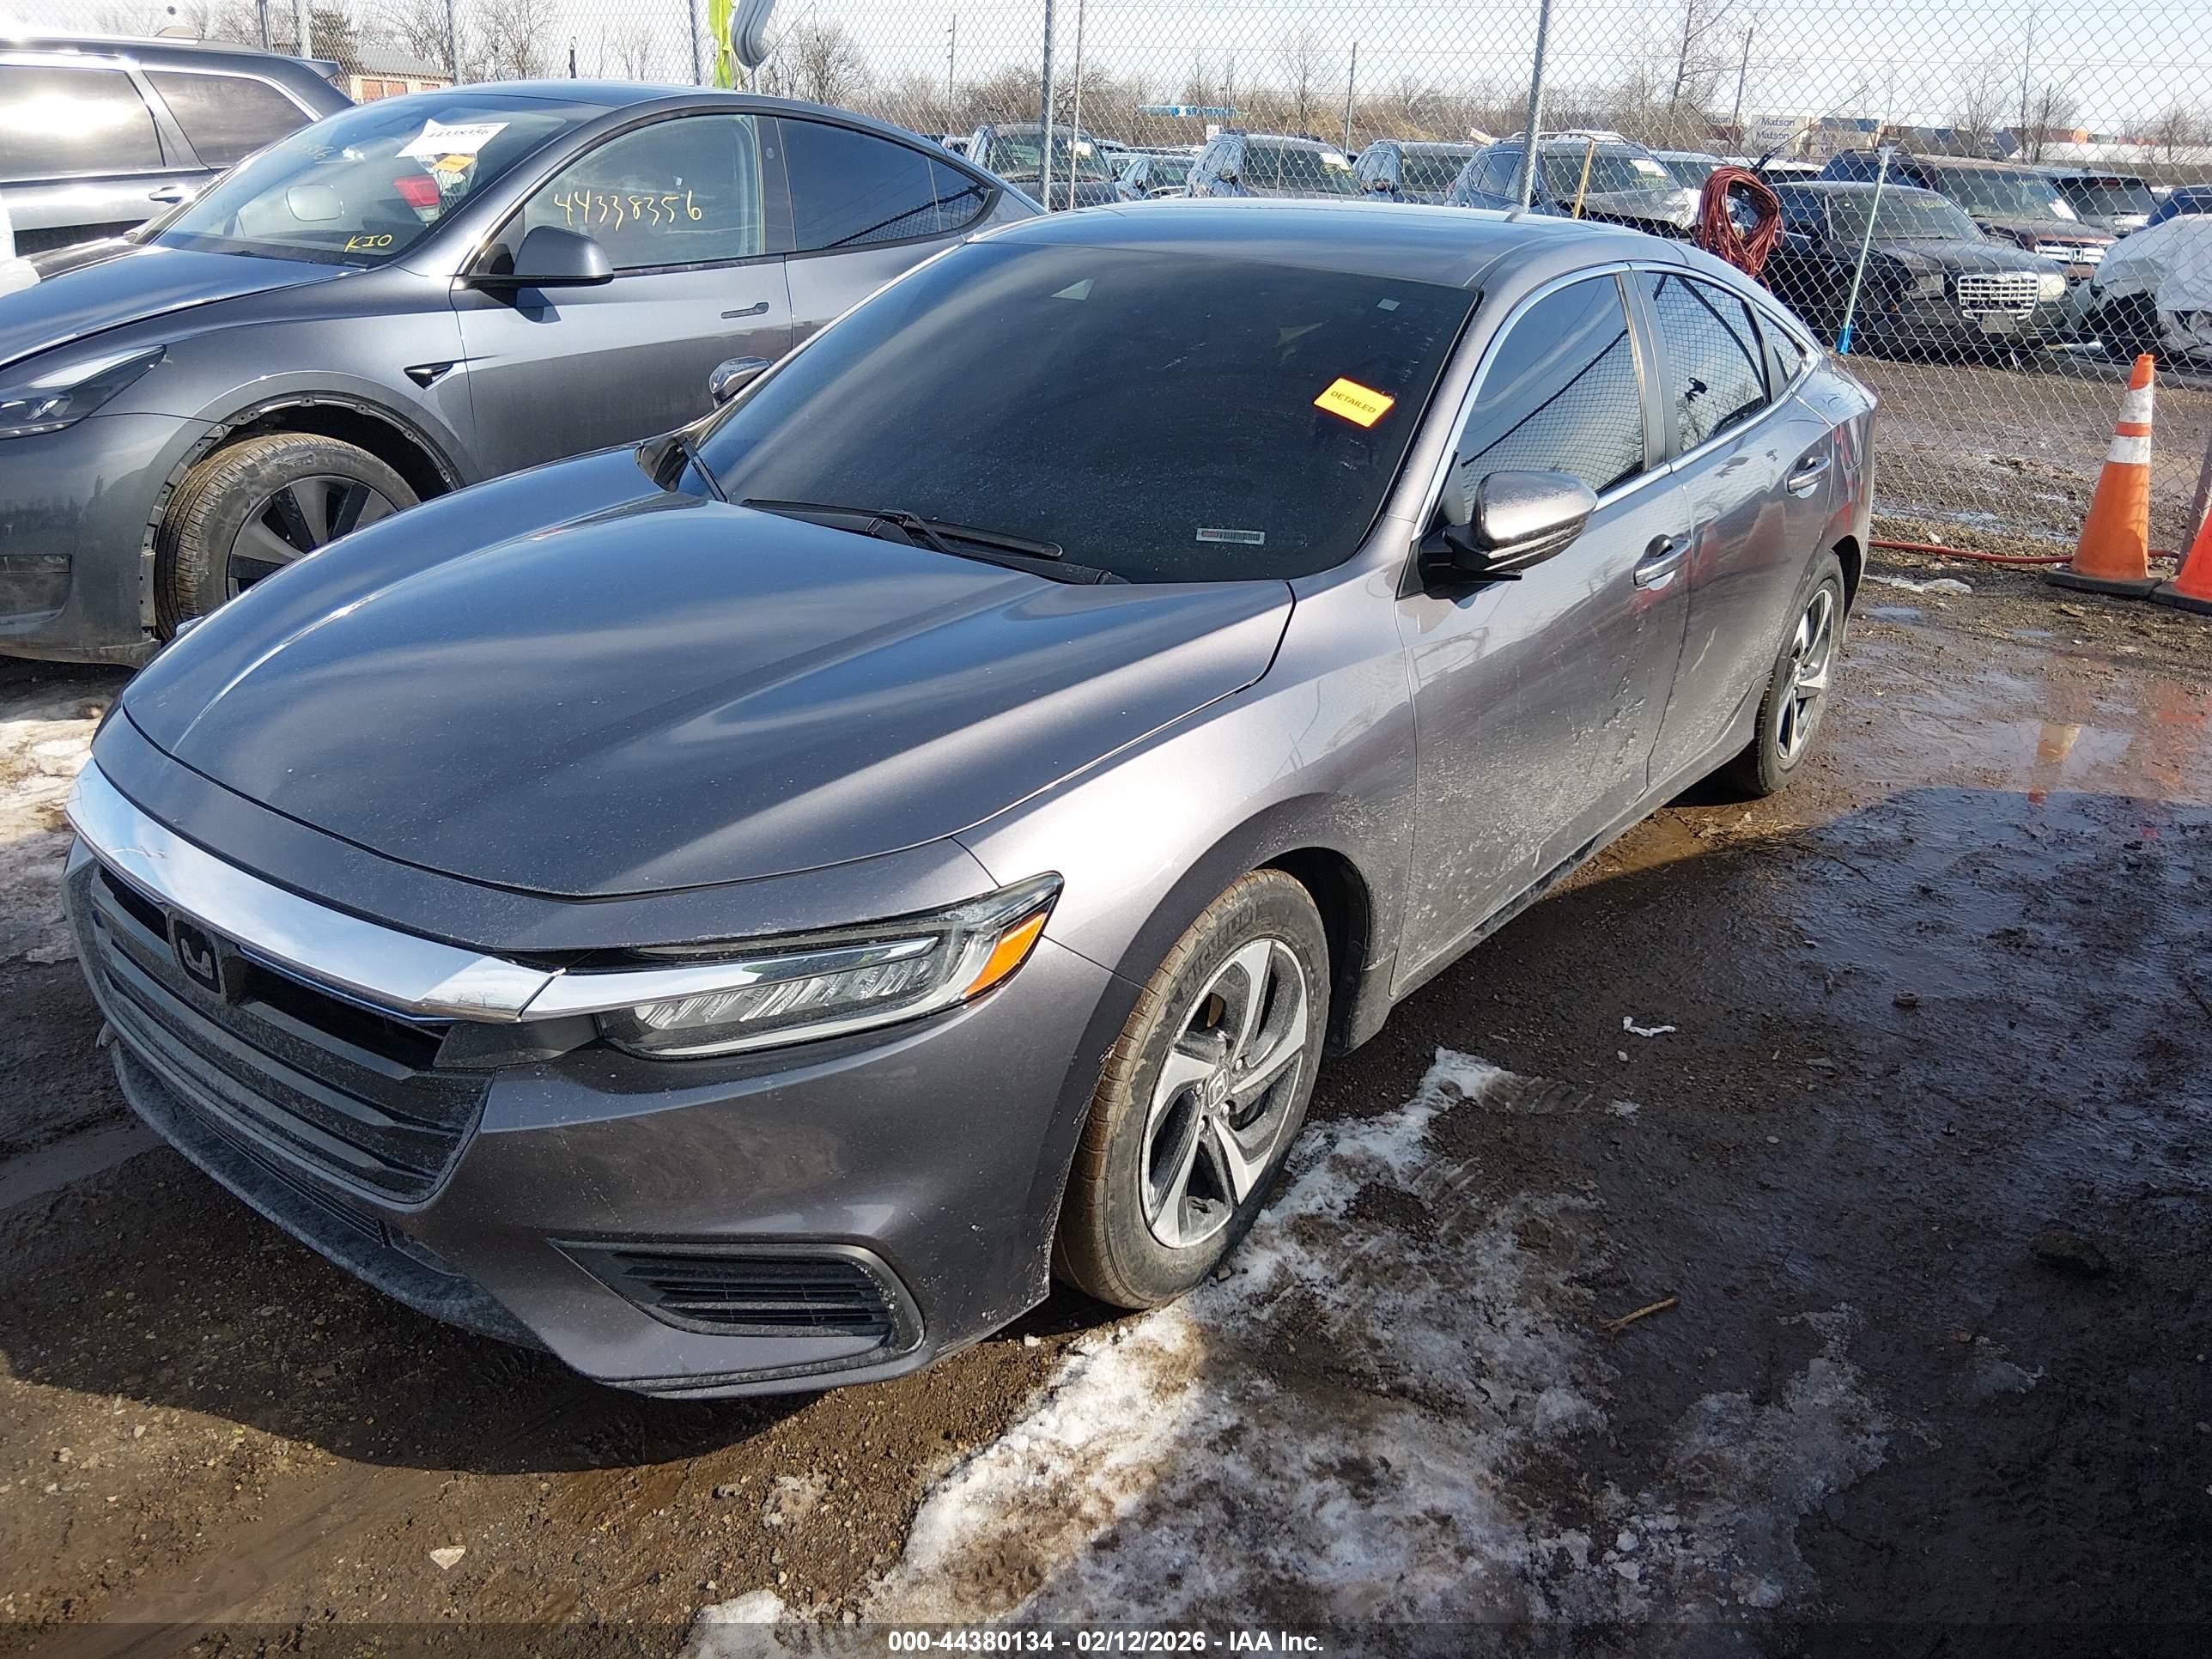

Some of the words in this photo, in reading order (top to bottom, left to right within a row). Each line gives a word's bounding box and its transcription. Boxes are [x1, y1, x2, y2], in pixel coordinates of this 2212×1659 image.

[1760, 117, 1796, 126] Matson
[1756, 131, 1790, 139] Matson
[553, 189, 703, 233] 44338356
[1329, 389, 1377, 415] DETAILED
